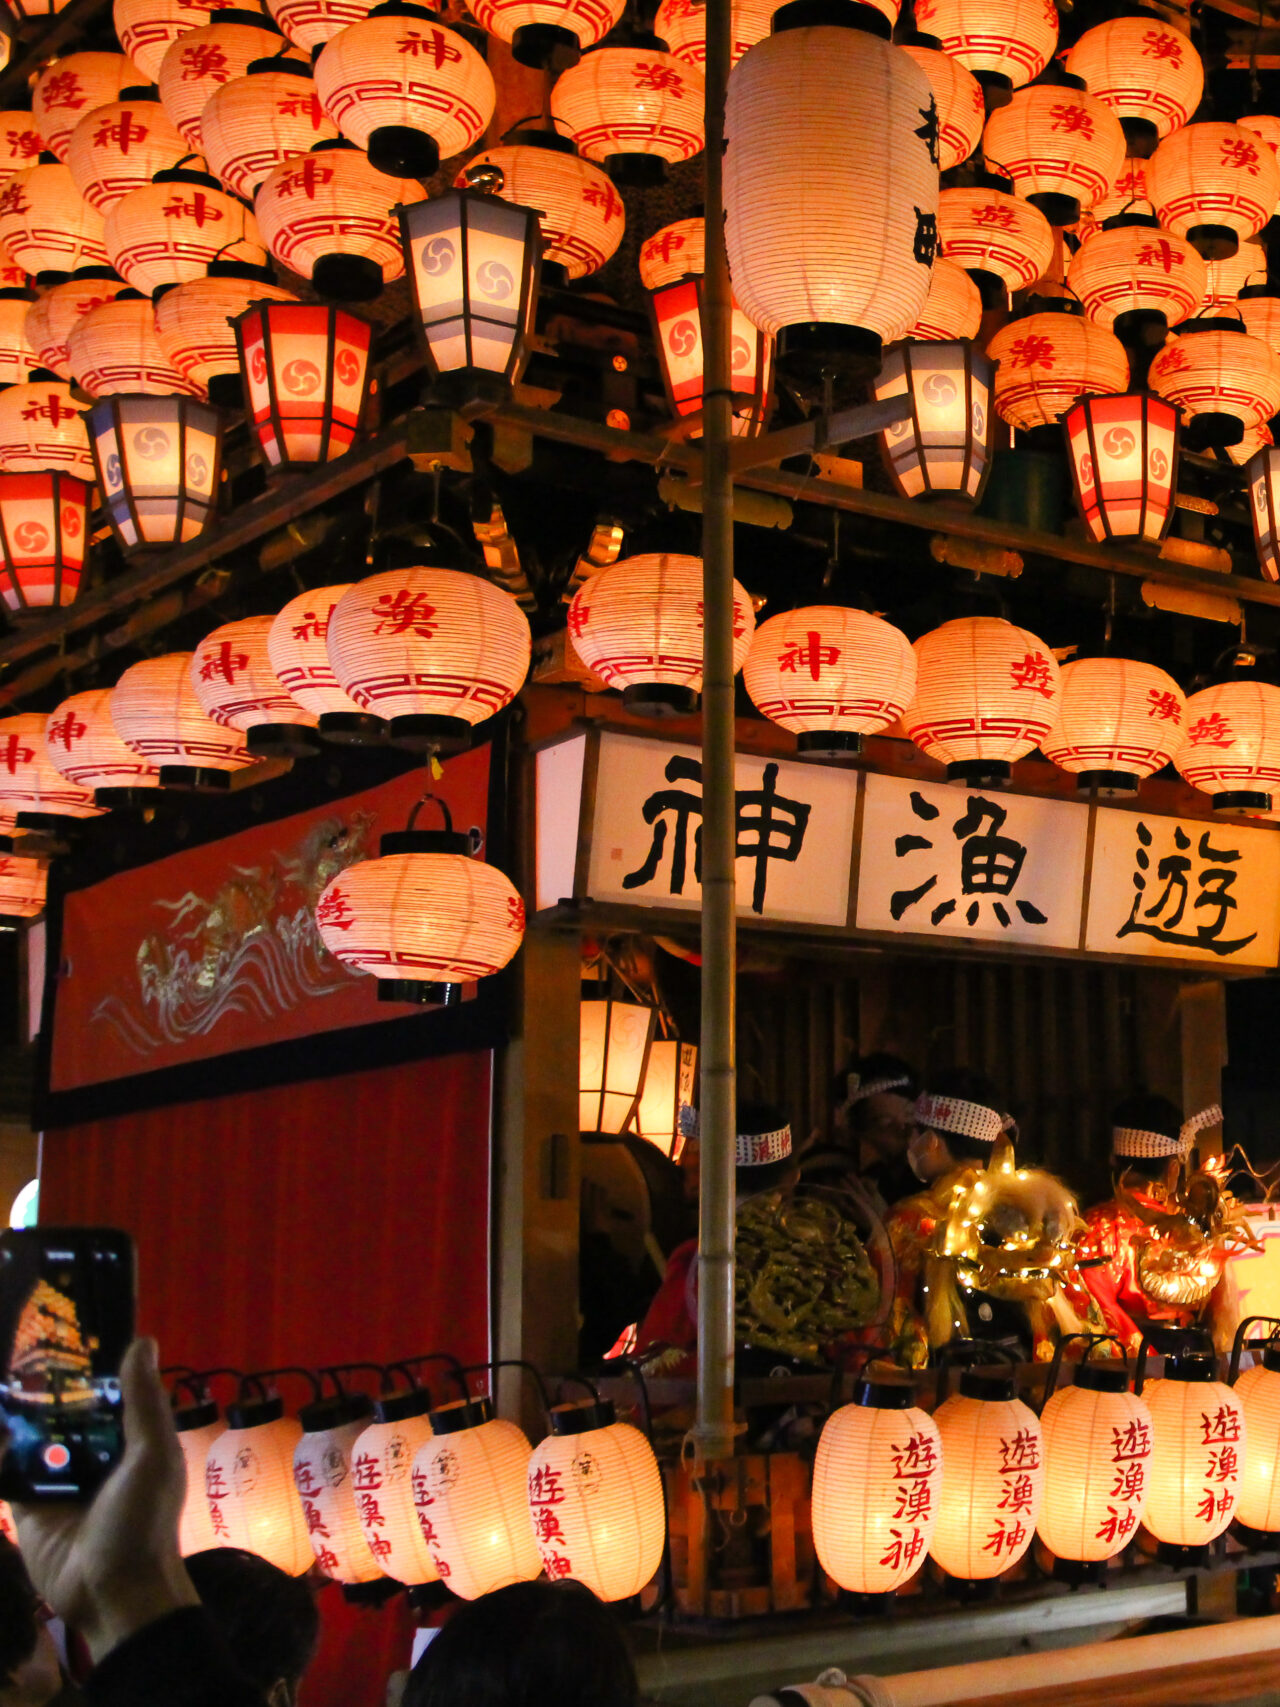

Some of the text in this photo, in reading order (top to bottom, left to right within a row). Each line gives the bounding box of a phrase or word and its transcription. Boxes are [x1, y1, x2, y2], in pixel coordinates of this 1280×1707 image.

[180, 44, 230, 82] 漁
[396, 28, 463, 71] 神
[1141, 30, 1183, 69] 漁
[41, 71, 88, 113] 遊
[631, 62, 685, 99] 漁
[277, 92, 327, 131] 神
[1049, 104, 1095, 142] 漁
[93, 110, 149, 156] 神
[1219, 138, 1261, 177] 漁
[275, 158, 334, 200] 神
[162, 191, 223, 228] 神
[582, 181, 623, 224] 神
[971, 204, 1021, 234] 遊
[644, 230, 686, 263] 神
[1136, 238, 1186, 274] 神
[1010, 334, 1057, 370] 漁
[1156, 347, 1192, 376] 遊
[21, 394, 78, 429] 神
[371, 589, 439, 639] 漁
[199, 641, 250, 685] 神
[778, 631, 842, 682] 神
[1010, 651, 1055, 699] 遊
[1146, 688, 1183, 726] 漁
[48, 711, 88, 752] 神
[1188, 712, 1238, 750] 遊
[1095, 1417, 1151, 1544] 遊漁神
[1194, 1404, 1242, 1523] 遊漁神
[879, 1431, 938, 1571] 遊漁神
[981, 1427, 1041, 1557] 遊漁神
[528, 1464, 572, 1580] 遊漁神
